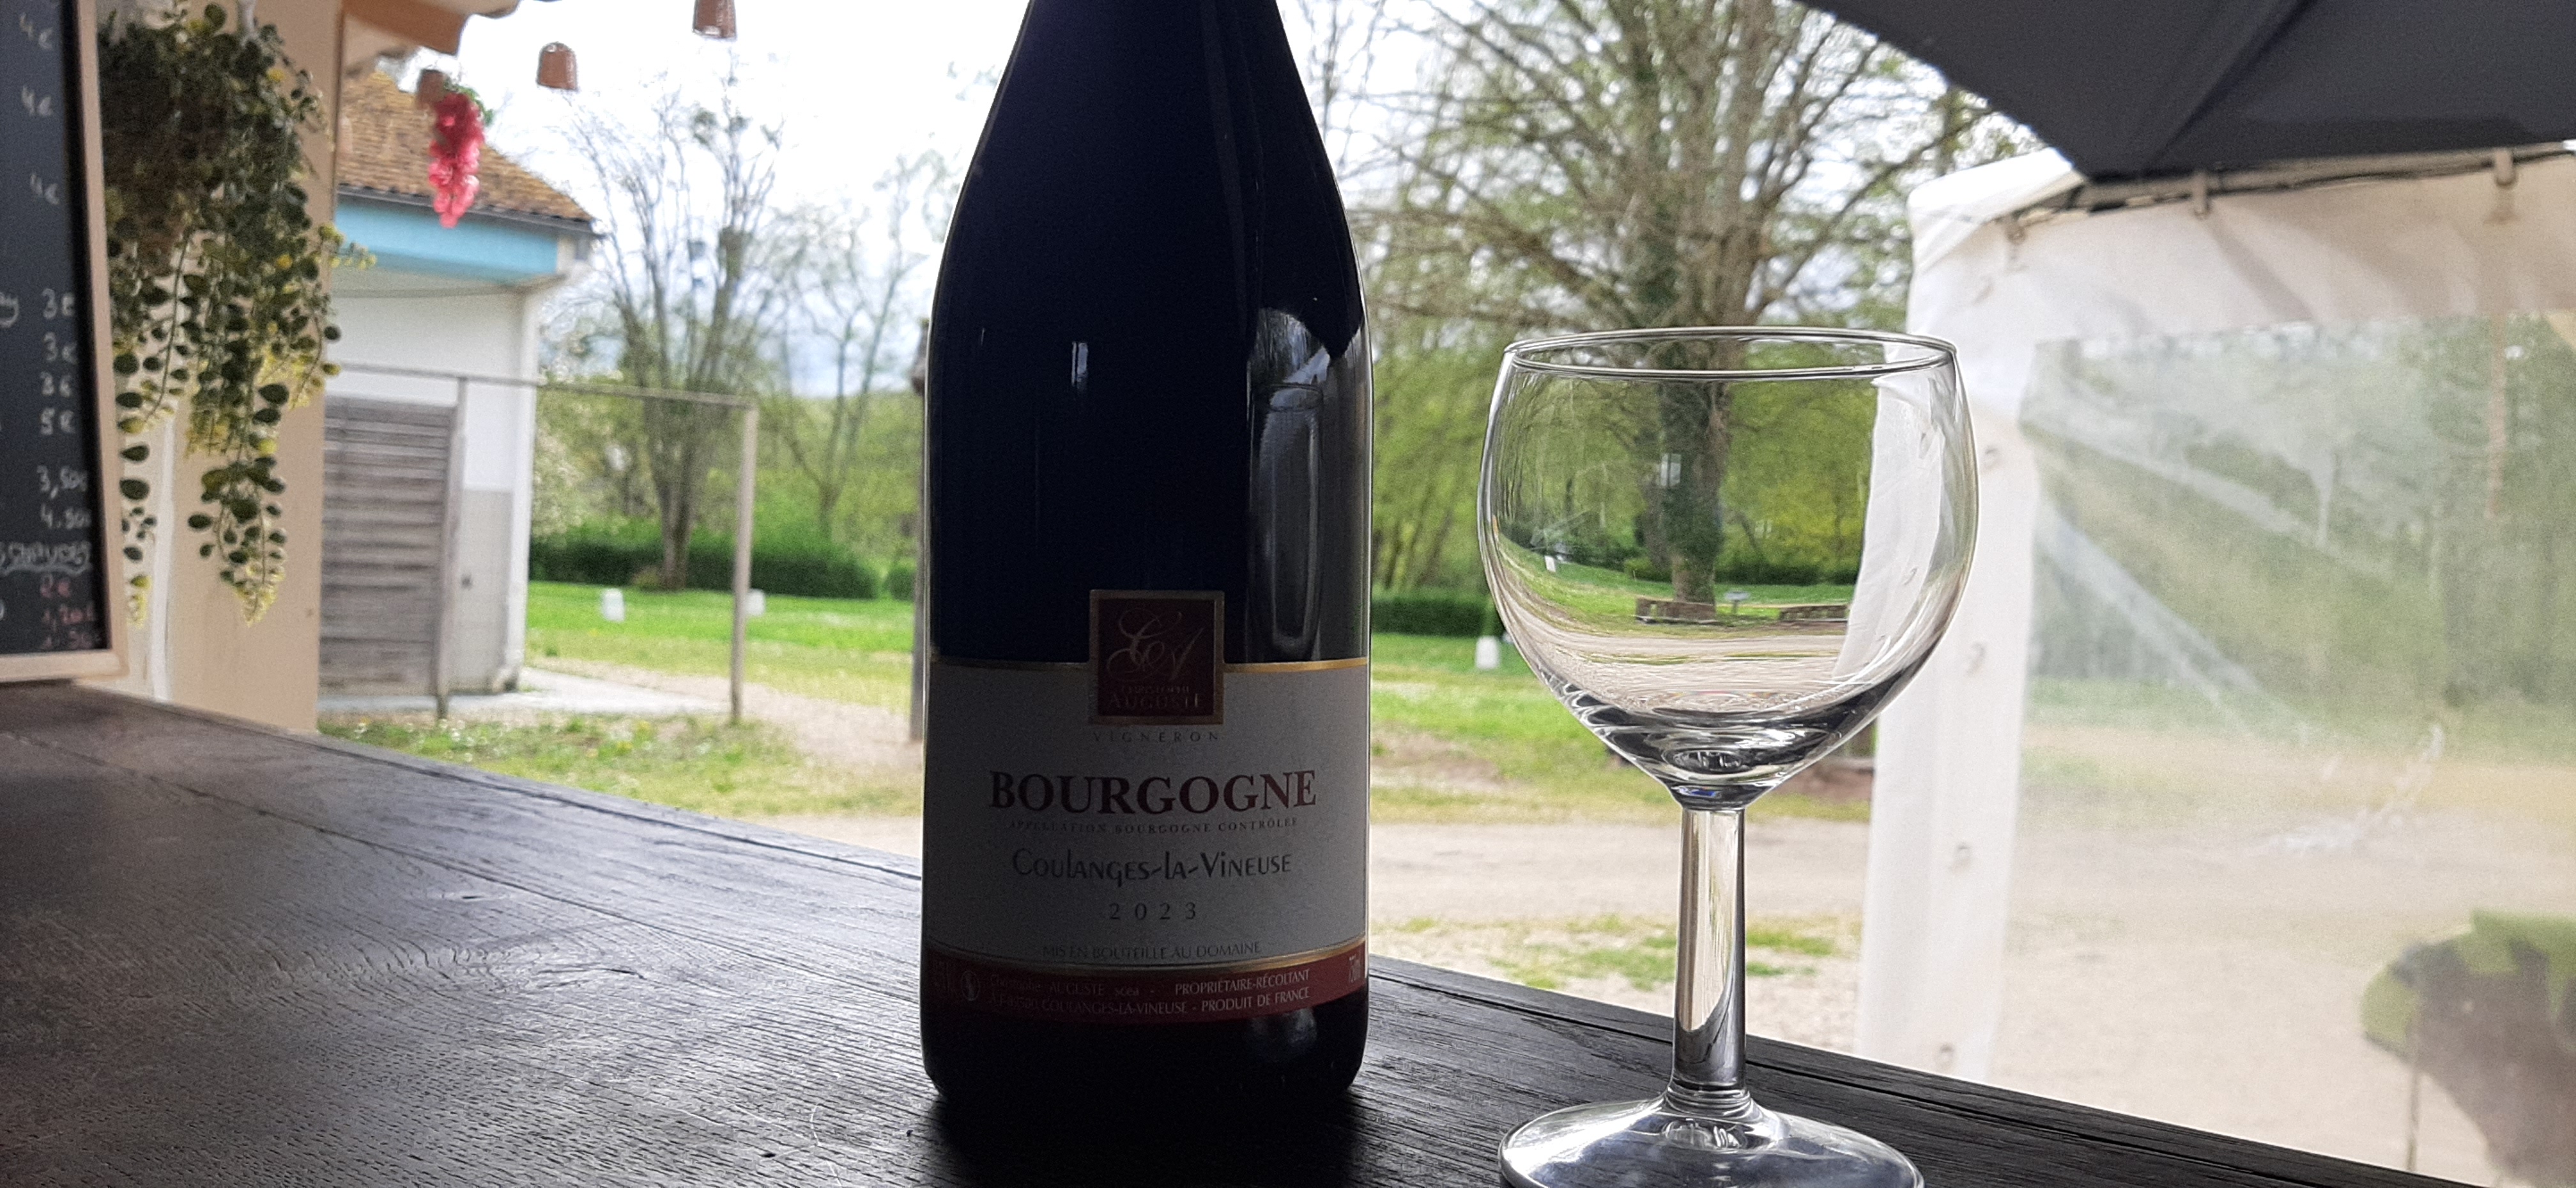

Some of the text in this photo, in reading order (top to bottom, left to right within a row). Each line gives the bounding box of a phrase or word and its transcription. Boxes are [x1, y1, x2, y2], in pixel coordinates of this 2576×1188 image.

[1093, 732, 1219, 743] VIGNERON
[989, 770, 1317, 816] BOURGOGNE
[1115, 823, 1211, 834] BOURGOGNE
[1109, 902, 1197, 920] 2023
[1043, 942, 1261, 961] MIS EN BOUTEILLE AU DOMAINE
[1175, 969, 1310, 995] PROPRIÉTAIRE-RÉCOLTANT
[1202, 996, 1252, 1012] PRODUIT
[1257, 994, 1270, 1007] DE
[1275, 987, 1310, 1005] FRANCE
